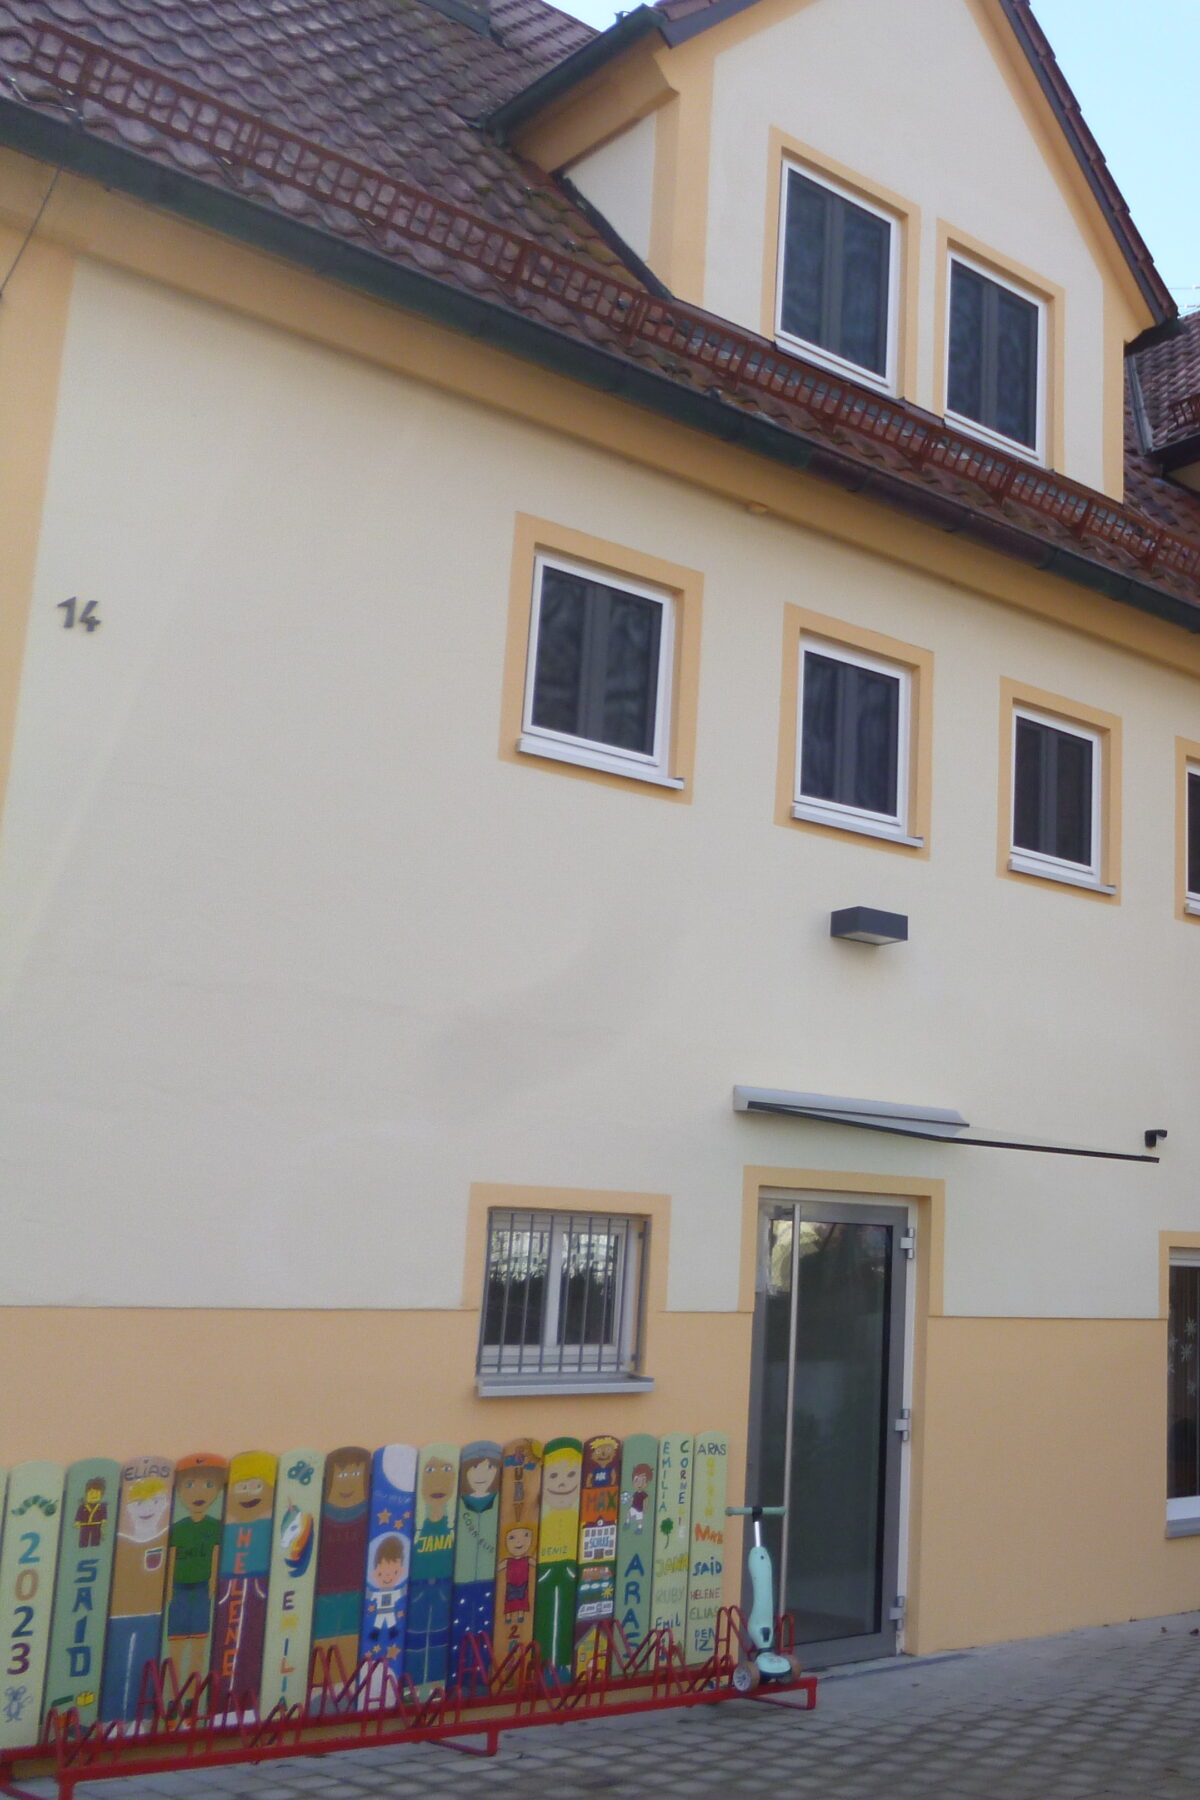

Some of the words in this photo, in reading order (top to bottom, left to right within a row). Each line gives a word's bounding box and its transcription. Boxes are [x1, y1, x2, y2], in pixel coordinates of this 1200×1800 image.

[56, 596, 101, 632] 14
[697, 1442, 727, 1456] ARAS
[6, 1531, 42, 1675] 2023
[68, 1558, 101, 1678] SAID
[221, 1527, 253, 1676] HELENE
